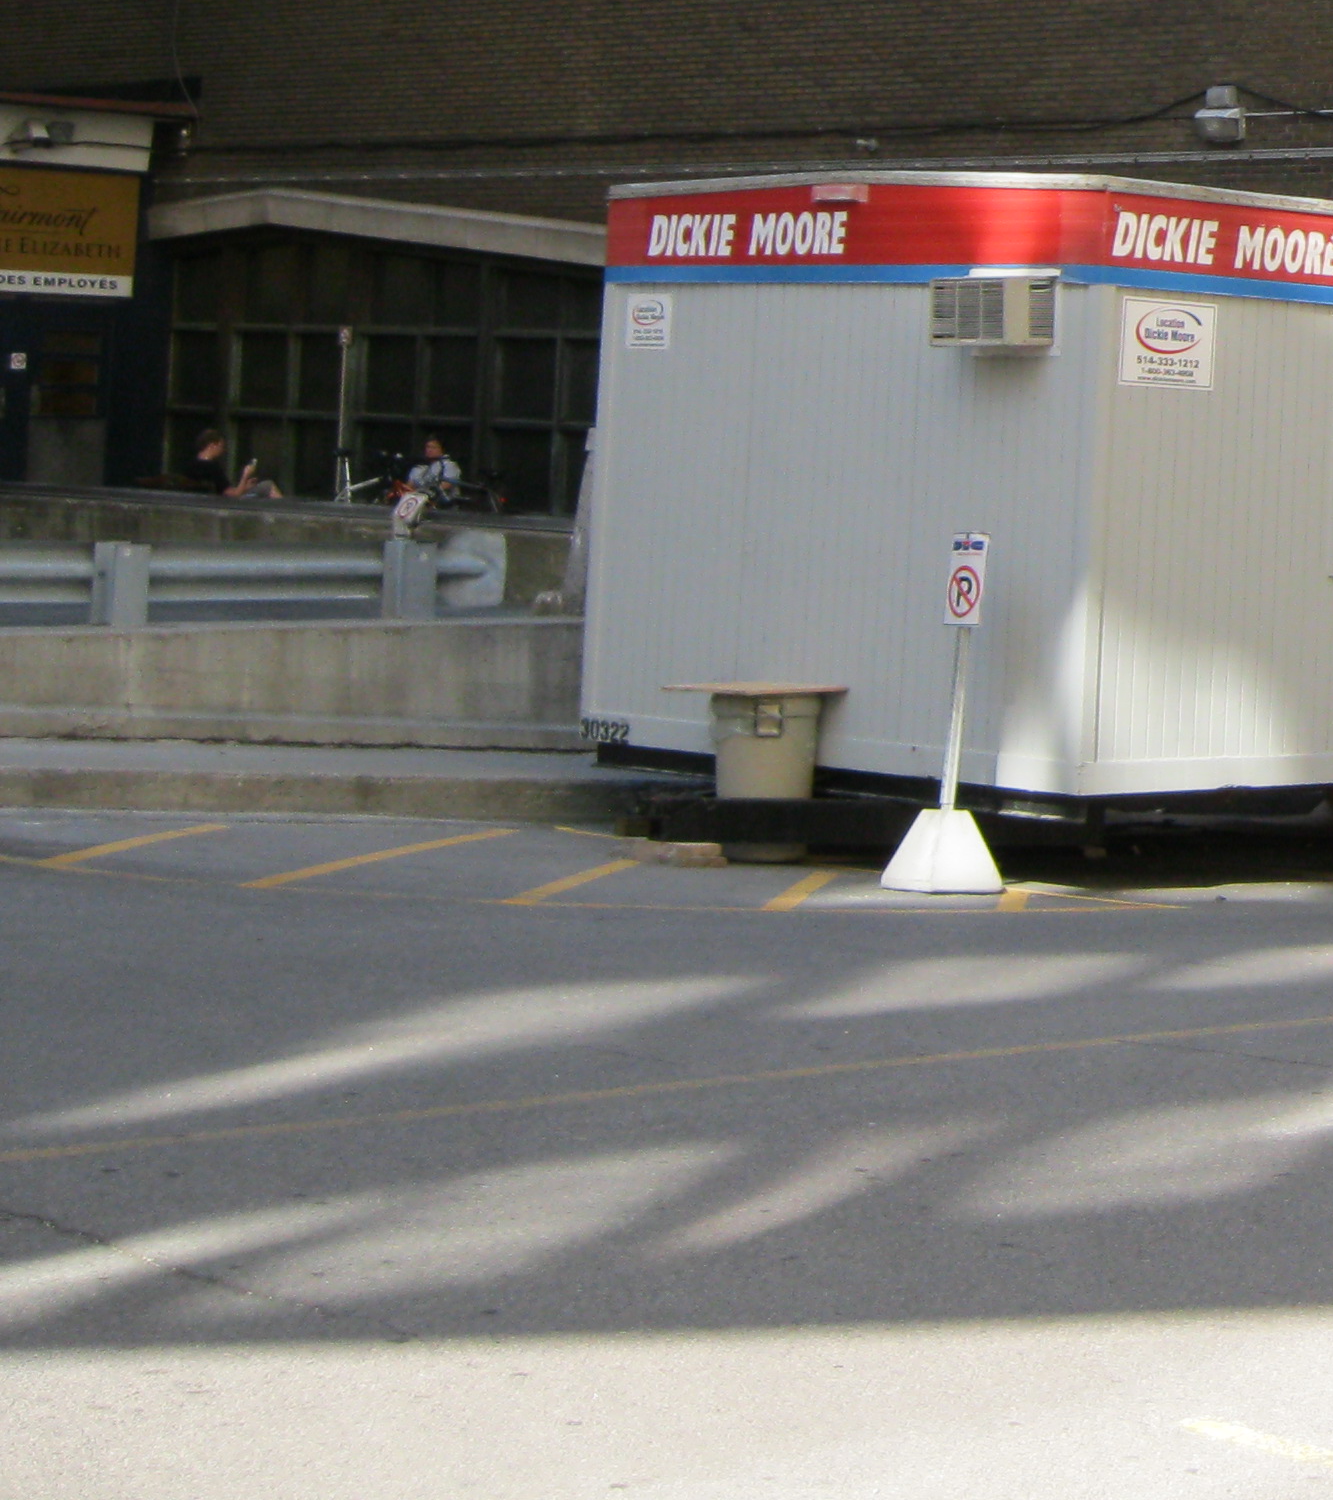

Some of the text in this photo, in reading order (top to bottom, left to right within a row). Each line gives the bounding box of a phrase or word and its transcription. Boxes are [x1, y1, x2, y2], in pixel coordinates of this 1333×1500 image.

[647, 211, 847, 257] DICKIE MOORE
[1112, 211, 1219, 266] DICKIE
[20, 237, 120, 259] ELIZABETH
[33, 276, 118, 290] EMPLOYÉS
[1144, 327, 1195, 342] Dickie Moore
[1136, 354, 1200, 368] 514-333-1212
